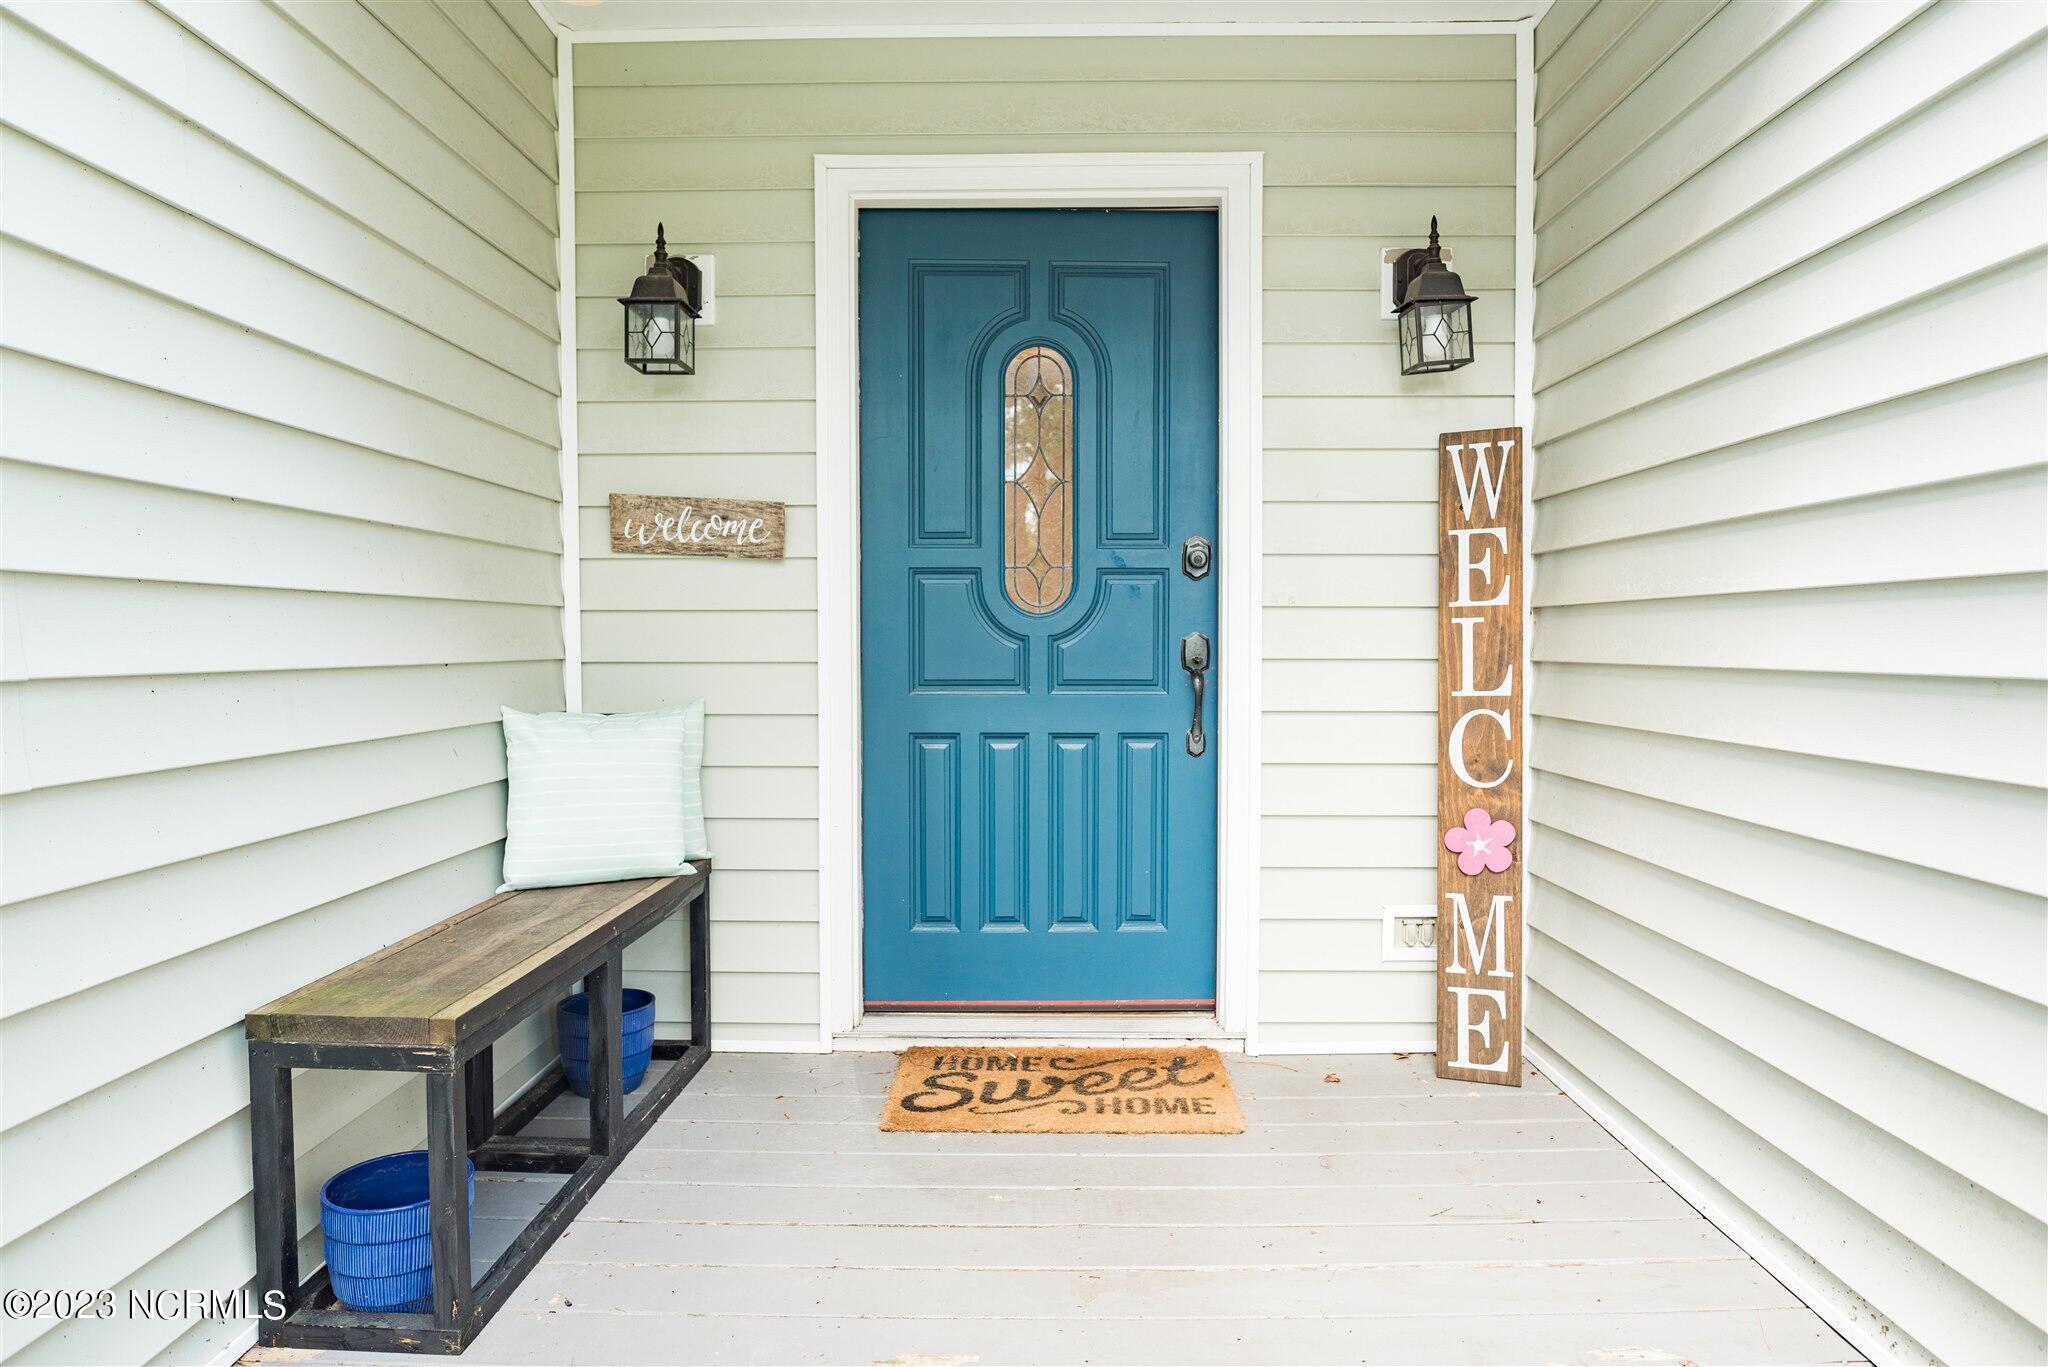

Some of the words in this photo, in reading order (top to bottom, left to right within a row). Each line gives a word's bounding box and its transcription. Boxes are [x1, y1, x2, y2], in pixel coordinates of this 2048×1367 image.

[623, 505, 771, 545] welcome
[1443, 440, 1516, 1073] WELCME
[932, 1055, 1043, 1072] HOME
[900, 1055, 1215, 1113] Sweet
[1094, 1096, 1217, 1115] HOME
